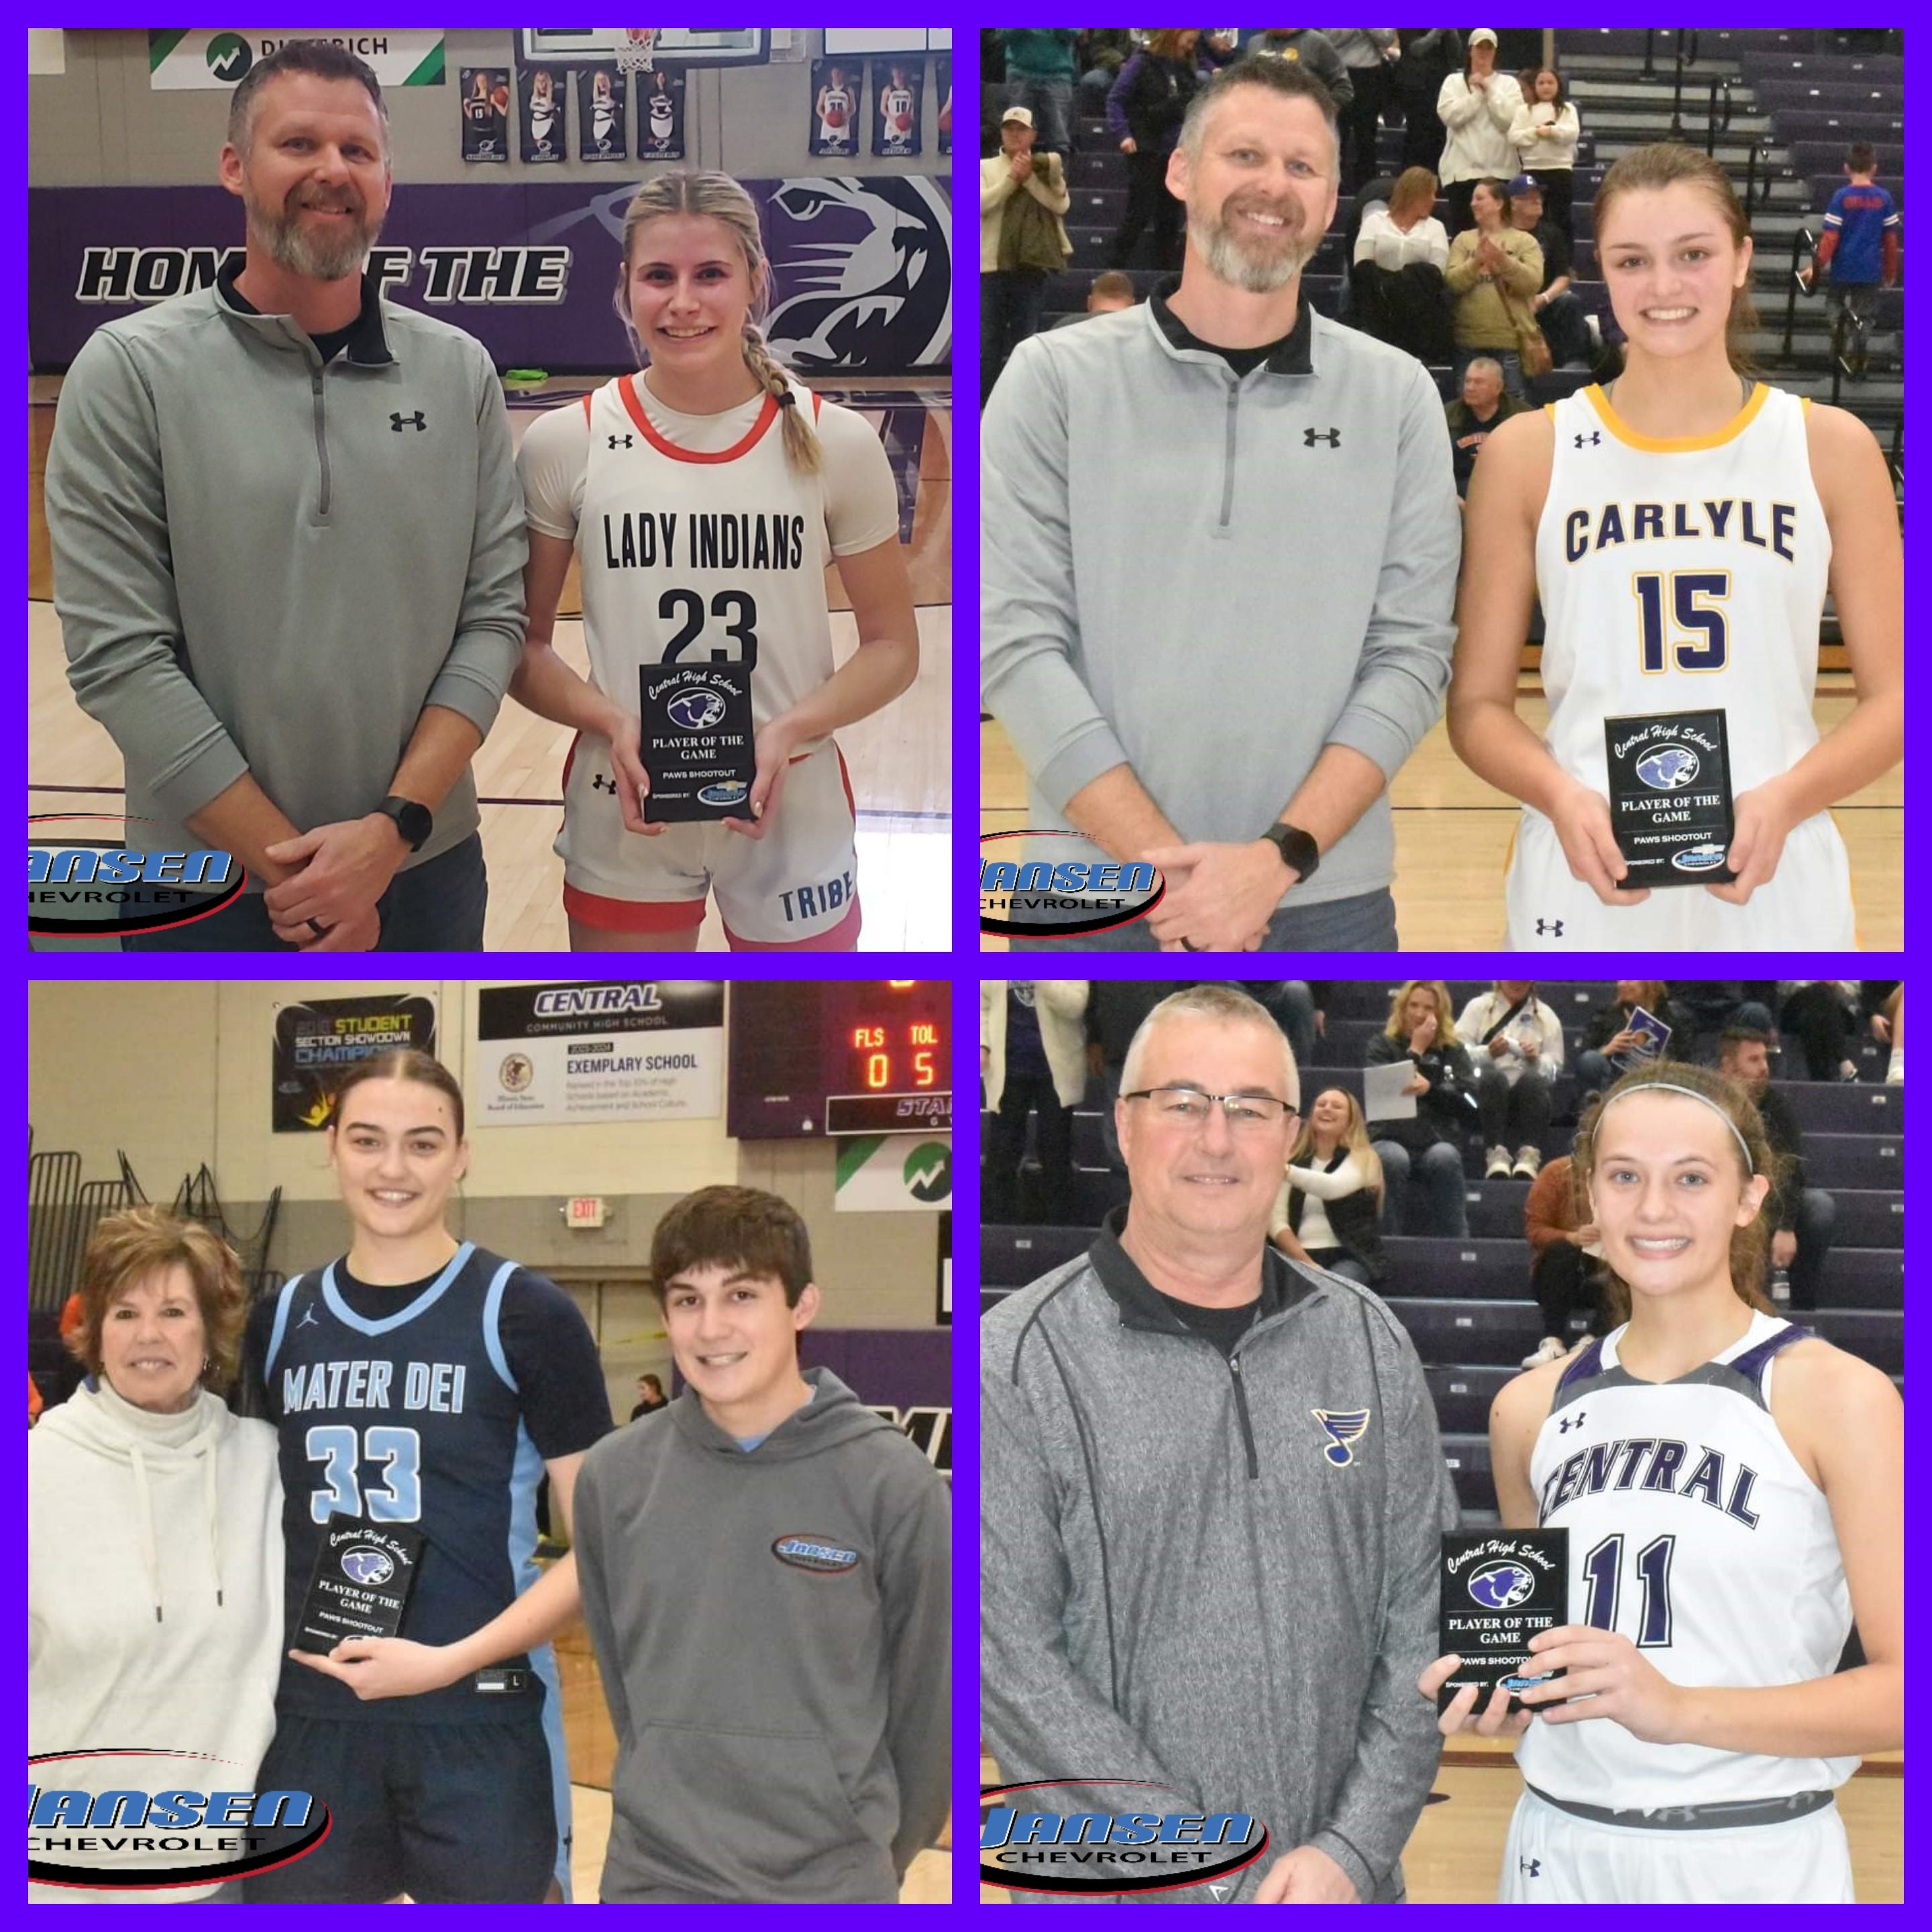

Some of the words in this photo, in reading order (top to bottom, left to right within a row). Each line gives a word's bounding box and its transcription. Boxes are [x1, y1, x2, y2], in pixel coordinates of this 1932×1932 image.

[419, 246, 570, 302] THE
[1564, 498, 1798, 564] CARLYLE
[604, 513, 677, 569] LADY
[690, 513, 804, 570] INDIANS
[659, 588, 758, 672] 23
[1632, 568, 1731, 674] 15
[648, 672, 680, 700] Central
[682, 670, 708, 685] High
[710, 674, 743, 696] School
[652, 737, 698, 749] PLAYER
[701, 736, 718, 746] OF
[720, 735, 744, 746] THE
[1614, 728, 1650, 759] Central
[1650, 724, 1679, 740] High
[1681, 728, 1718, 751] School
[680, 749, 717, 760] GAME
[663, 771, 688, 780] PAWS
[689, 769, 736, 778] SHOOTOUT
[1621, 798, 1671, 812] PLAYER
[1674, 797, 1691, 808] OF
[1693, 795, 1721, 806] THE
[1652, 810, 1692, 823] GAME
[1633, 835, 1660, 845] PAWS
[1662, 833, 1713, 843] SHOOTOUT
[778, 871, 853, 922] TRIBE
[534, 984, 663, 1018] CENTRAL
[335, 1014, 413, 1034] STUDENT
[527, 1020, 590, 1032] COMMUNITY
[593, 1018, 620, 1028] HIGH
[625, 1016, 668, 1027] SCHOOL
[295, 1036, 341, 1048] SECTION
[345, 1032, 411, 1045] SHOWDOWN
[855, 1028, 885, 1048] FLS
[911, 1025, 938, 1044] TOL
[567, 1057, 643, 1075] EXEMPLARY
[645, 1054, 698, 1071] SCHOOL
[869, 1054, 888, 1087] 0
[915, 1053, 933, 1085] 5
[896, 1097, 951, 1116] STA
[574, 1199, 596, 1218] EXIT
[283, 1360, 393, 1415] MATER
[404, 1362, 466, 1413] DEI
[306, 1425, 422, 1524] 33
[1538, 1438, 1760, 1530] CENTRAL
[330, 1529, 362, 1547] Central
[1448, 1543, 1485, 1574] Central
[1487, 1540, 1517, 1556] High
[1518, 1544, 1556, 1570] School
[319, 1580, 360, 1599] PLAYER
[361, 1591, 377, 1602] OF
[378, 1595, 401, 1609] THE
[1582, 1534, 1676, 1648] 11
[340, 1598, 372, 1614] GAME
[319, 1611, 341, 1623] PAWS
[1448, 1619, 1502, 1630] PLAYER
[1504, 1617, 1523, 1628] OF
[1525, 1617, 1554, 1627] THE
[1480, 1633, 1521, 1644] GAME
[1461, 1657, 1487, 1665] PAWS
[1488, 1656, 1532, 1664] SHOOTO
[513, 1674, 520, 1686] L
